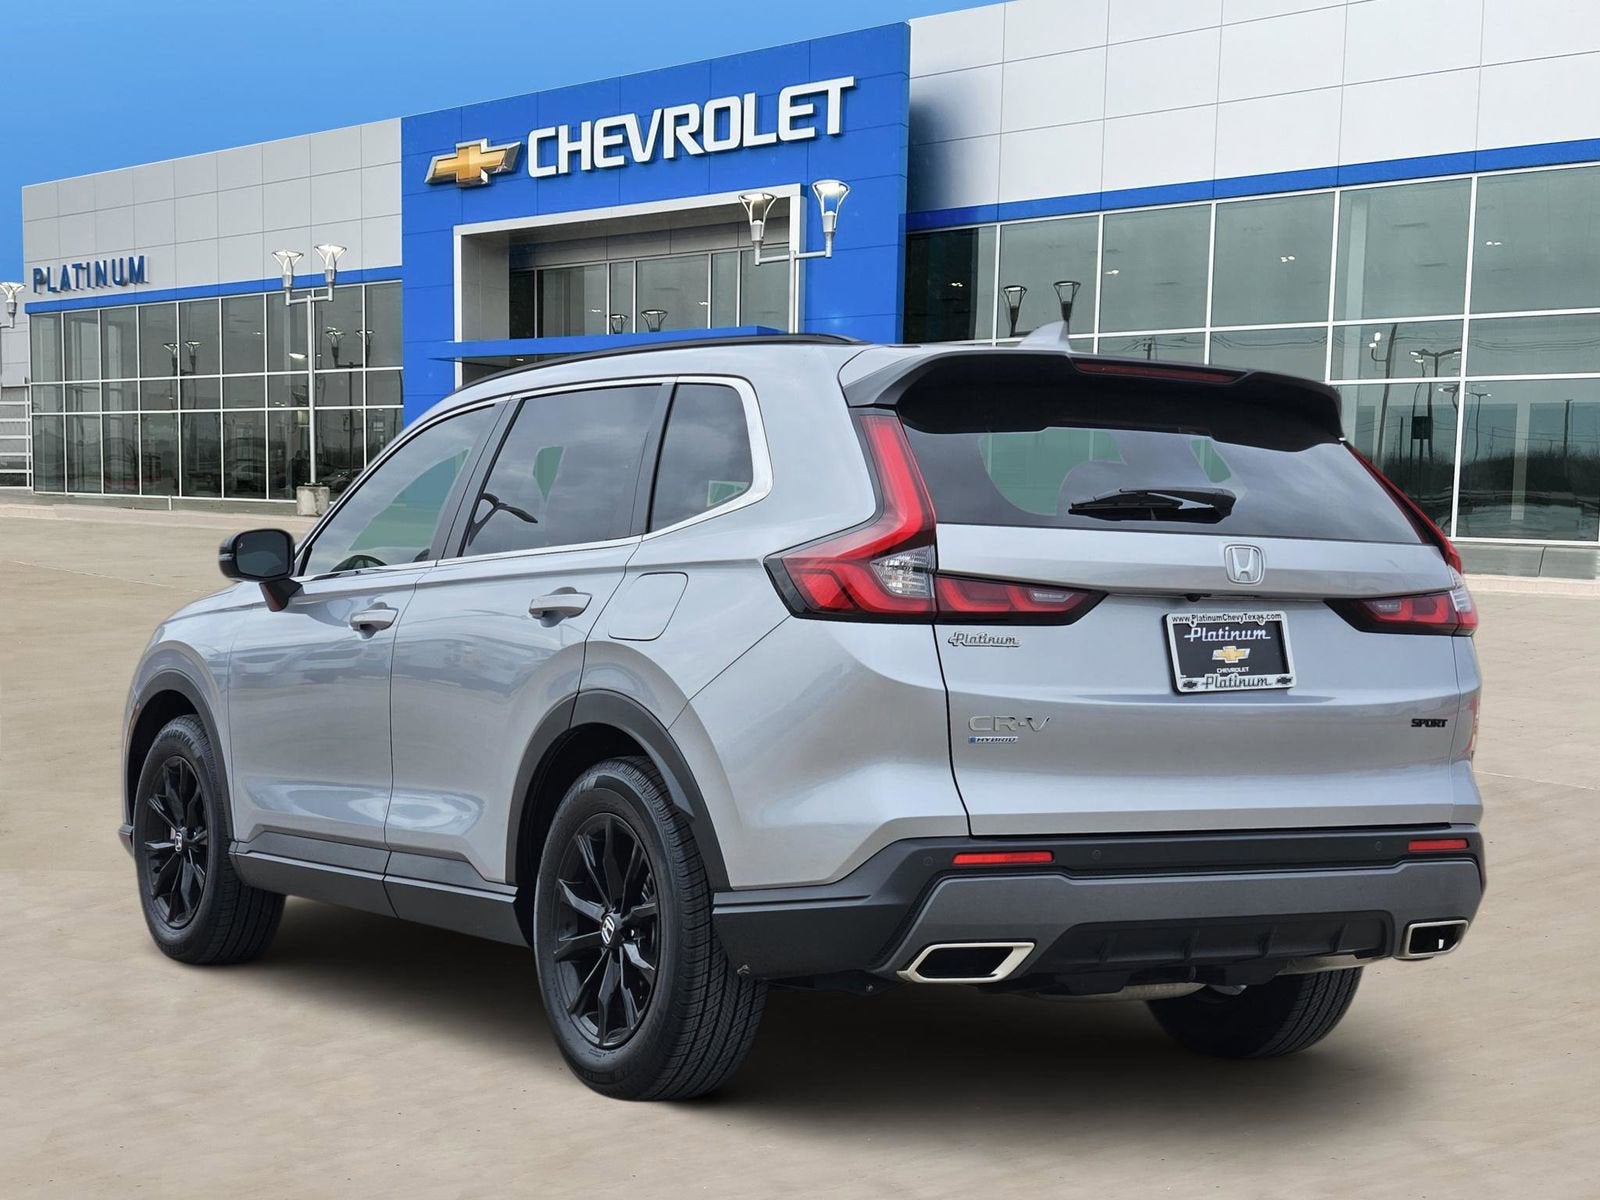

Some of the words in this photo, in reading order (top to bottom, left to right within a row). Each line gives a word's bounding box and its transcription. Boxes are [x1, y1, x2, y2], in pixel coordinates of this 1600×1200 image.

[527, 75, 855, 179] CHEVROLET
[33, 255, 146, 294] PLATINUM
[948, 631, 1021, 648] Platinum
[1184, 627, 1272, 642] Platinum
[1216, 666, 1250, 674] CHEVROLET
[1201, 674, 1272, 690] Platinum
[968, 715, 1050, 732] CR-V
[1411, 718, 1449, 728] SPORT
